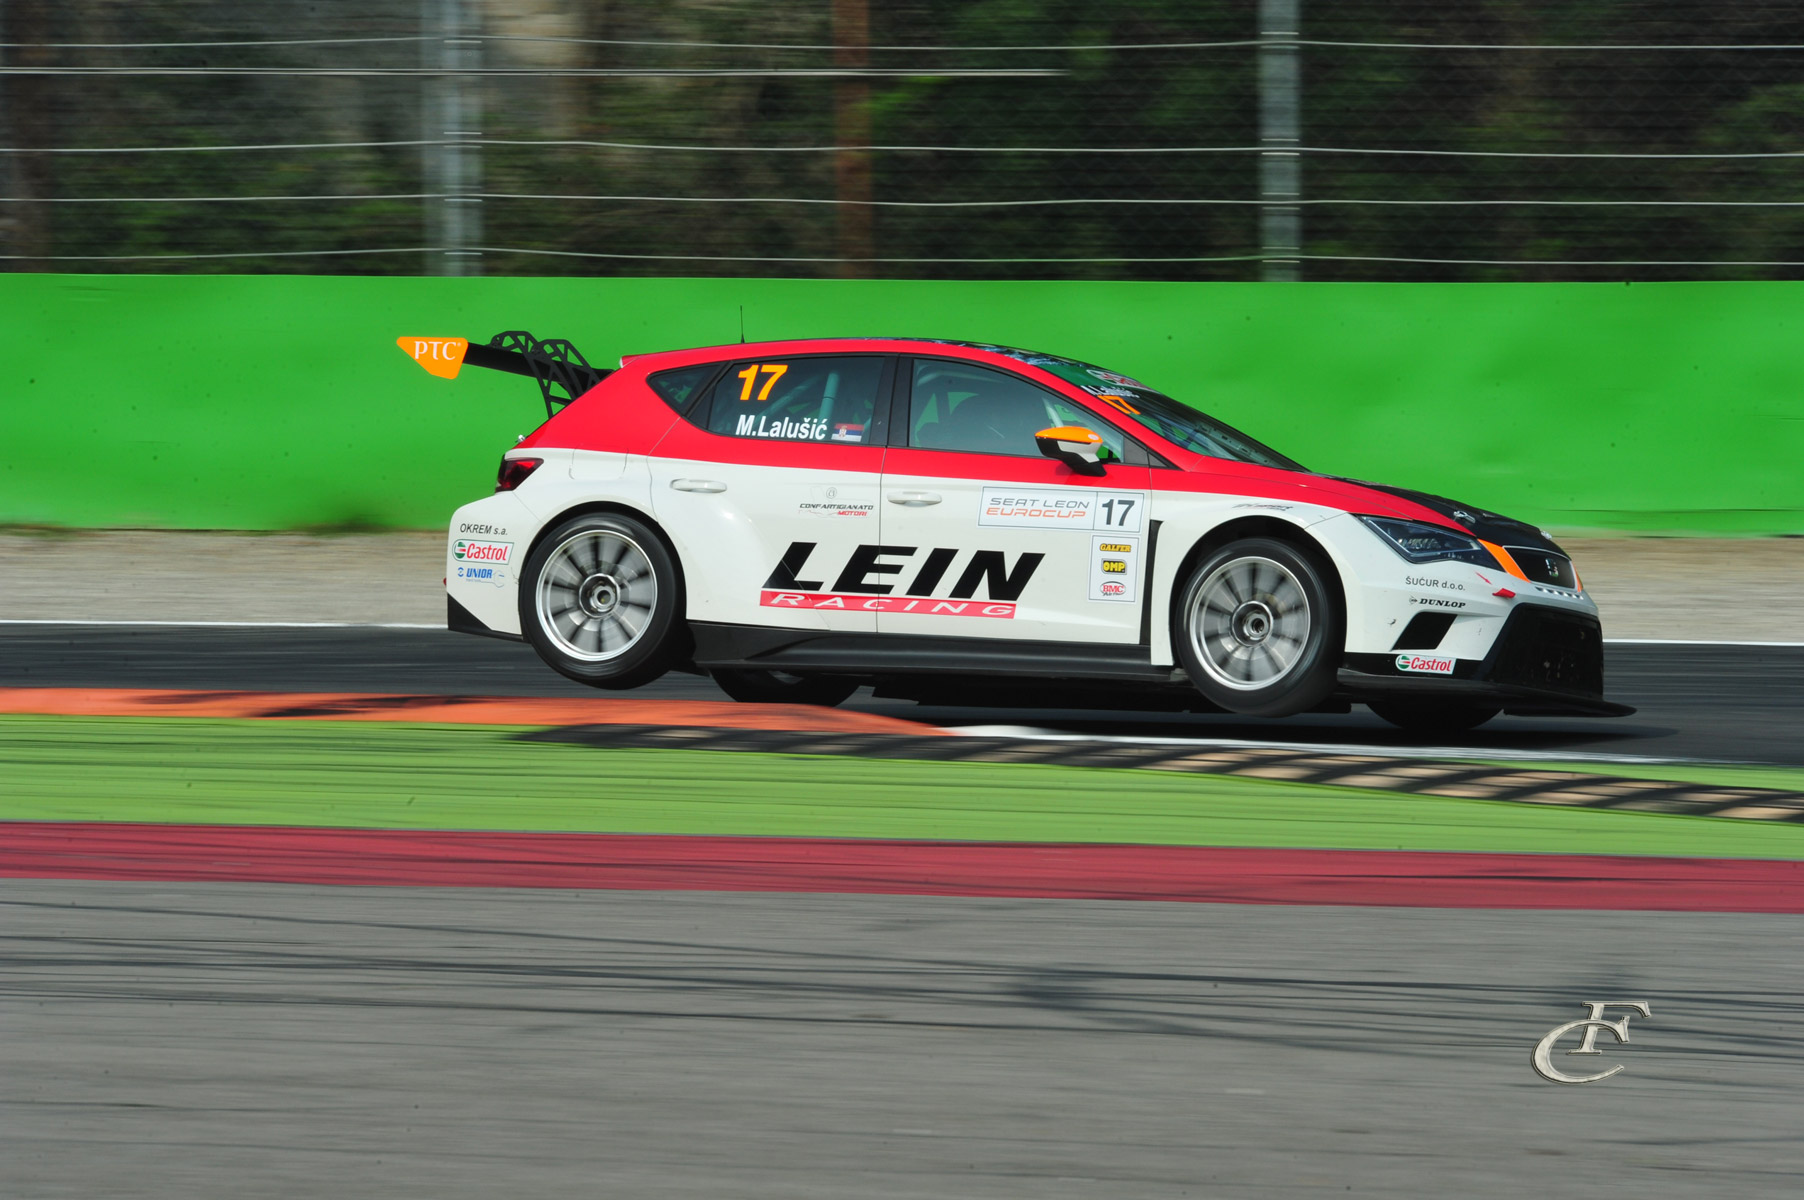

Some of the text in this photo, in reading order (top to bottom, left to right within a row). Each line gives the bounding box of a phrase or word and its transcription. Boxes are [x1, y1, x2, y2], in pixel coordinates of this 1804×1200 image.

[414, 341, 457, 360] PTC
[738, 364, 788, 401] 17
[735, 414, 828, 440] M.Lalušić
[799, 503, 874, 511] CONFARTIGIANATO
[990, 498, 1090, 509] SEAT LEON
[986, 507, 1086, 518] EUROCUP
[1101, 499, 1135, 526] 17
[460, 523, 508, 536] OKREM s.a.
[466, 543, 508, 561] Castrol
[1100, 543, 1131, 553] GALFER
[466, 567, 493, 579] UNIOR
[762, 541, 1046, 601] LEIN
[1103, 561, 1125, 572] OMP
[1103, 584, 1125, 593] BMC
[1405, 576, 1466, 591] ŠUĆUR d.o.o.
[770, 593, 1015, 616] RACING
[1419, 598, 1466, 608] DUNLOP
[1411, 657, 1452, 672] Castrol
